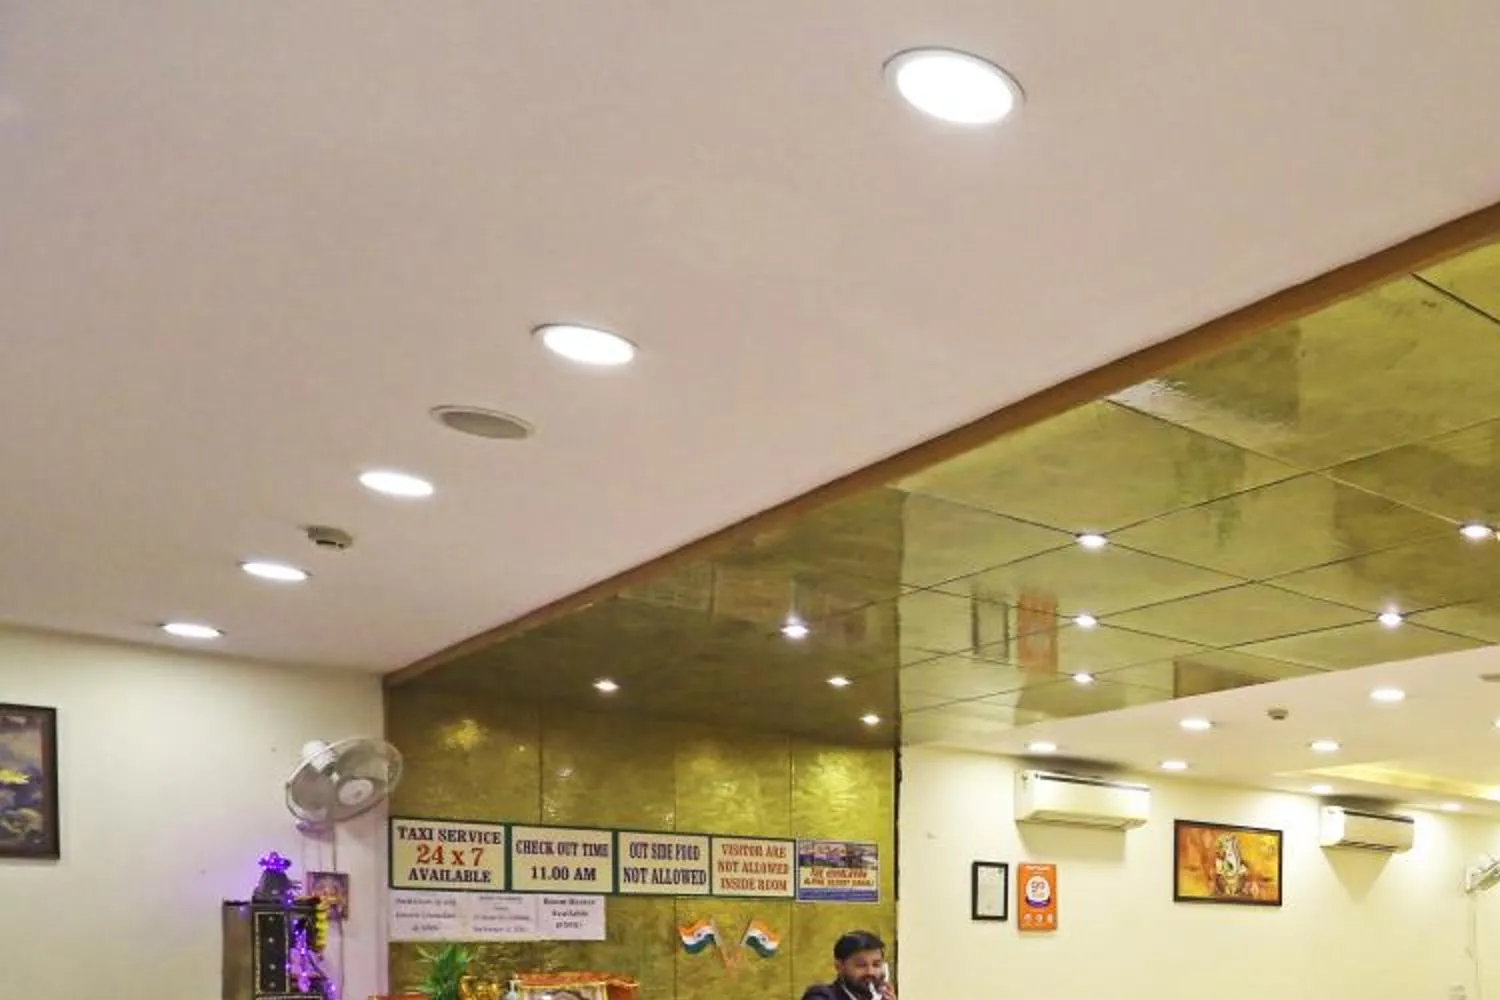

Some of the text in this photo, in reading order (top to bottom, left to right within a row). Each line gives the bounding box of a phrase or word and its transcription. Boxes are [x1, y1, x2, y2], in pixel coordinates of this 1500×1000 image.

[398, 826, 501, 844] TAXI SERVICE
[416, 844, 484, 866] 24 x 7
[515, 840, 609, 856] CHECK OUT TIME
[630, 842, 701, 860] OUT SIDE FOOD
[765, 845, 787, 858] ARE
[408, 867, 491, 883] AVAILABLE
[532, 865, 597, 880] 11.00 AM
[717, 861, 789, 874] NOT ALLOWED
[623, 867, 707, 885] NOT ALLOWED
[720, 878, 787, 891] INSIDE ROOM
